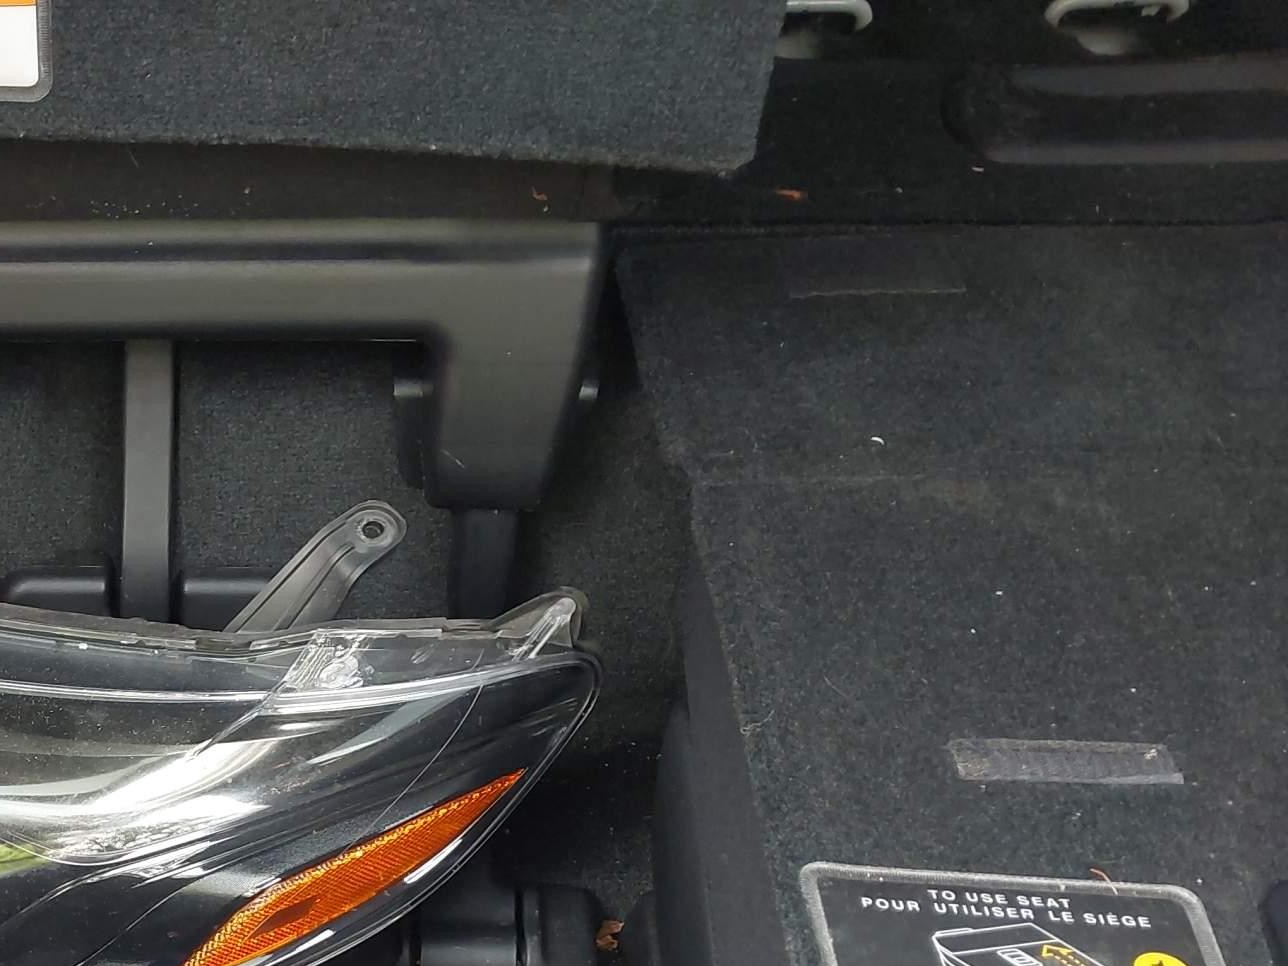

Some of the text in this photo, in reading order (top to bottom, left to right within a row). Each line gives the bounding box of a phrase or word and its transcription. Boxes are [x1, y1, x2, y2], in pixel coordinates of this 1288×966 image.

[860, 896, 1153, 929] POUR UTILISER LE SIÈGE
[927, 889, 1071, 910] TO USE SEAT
